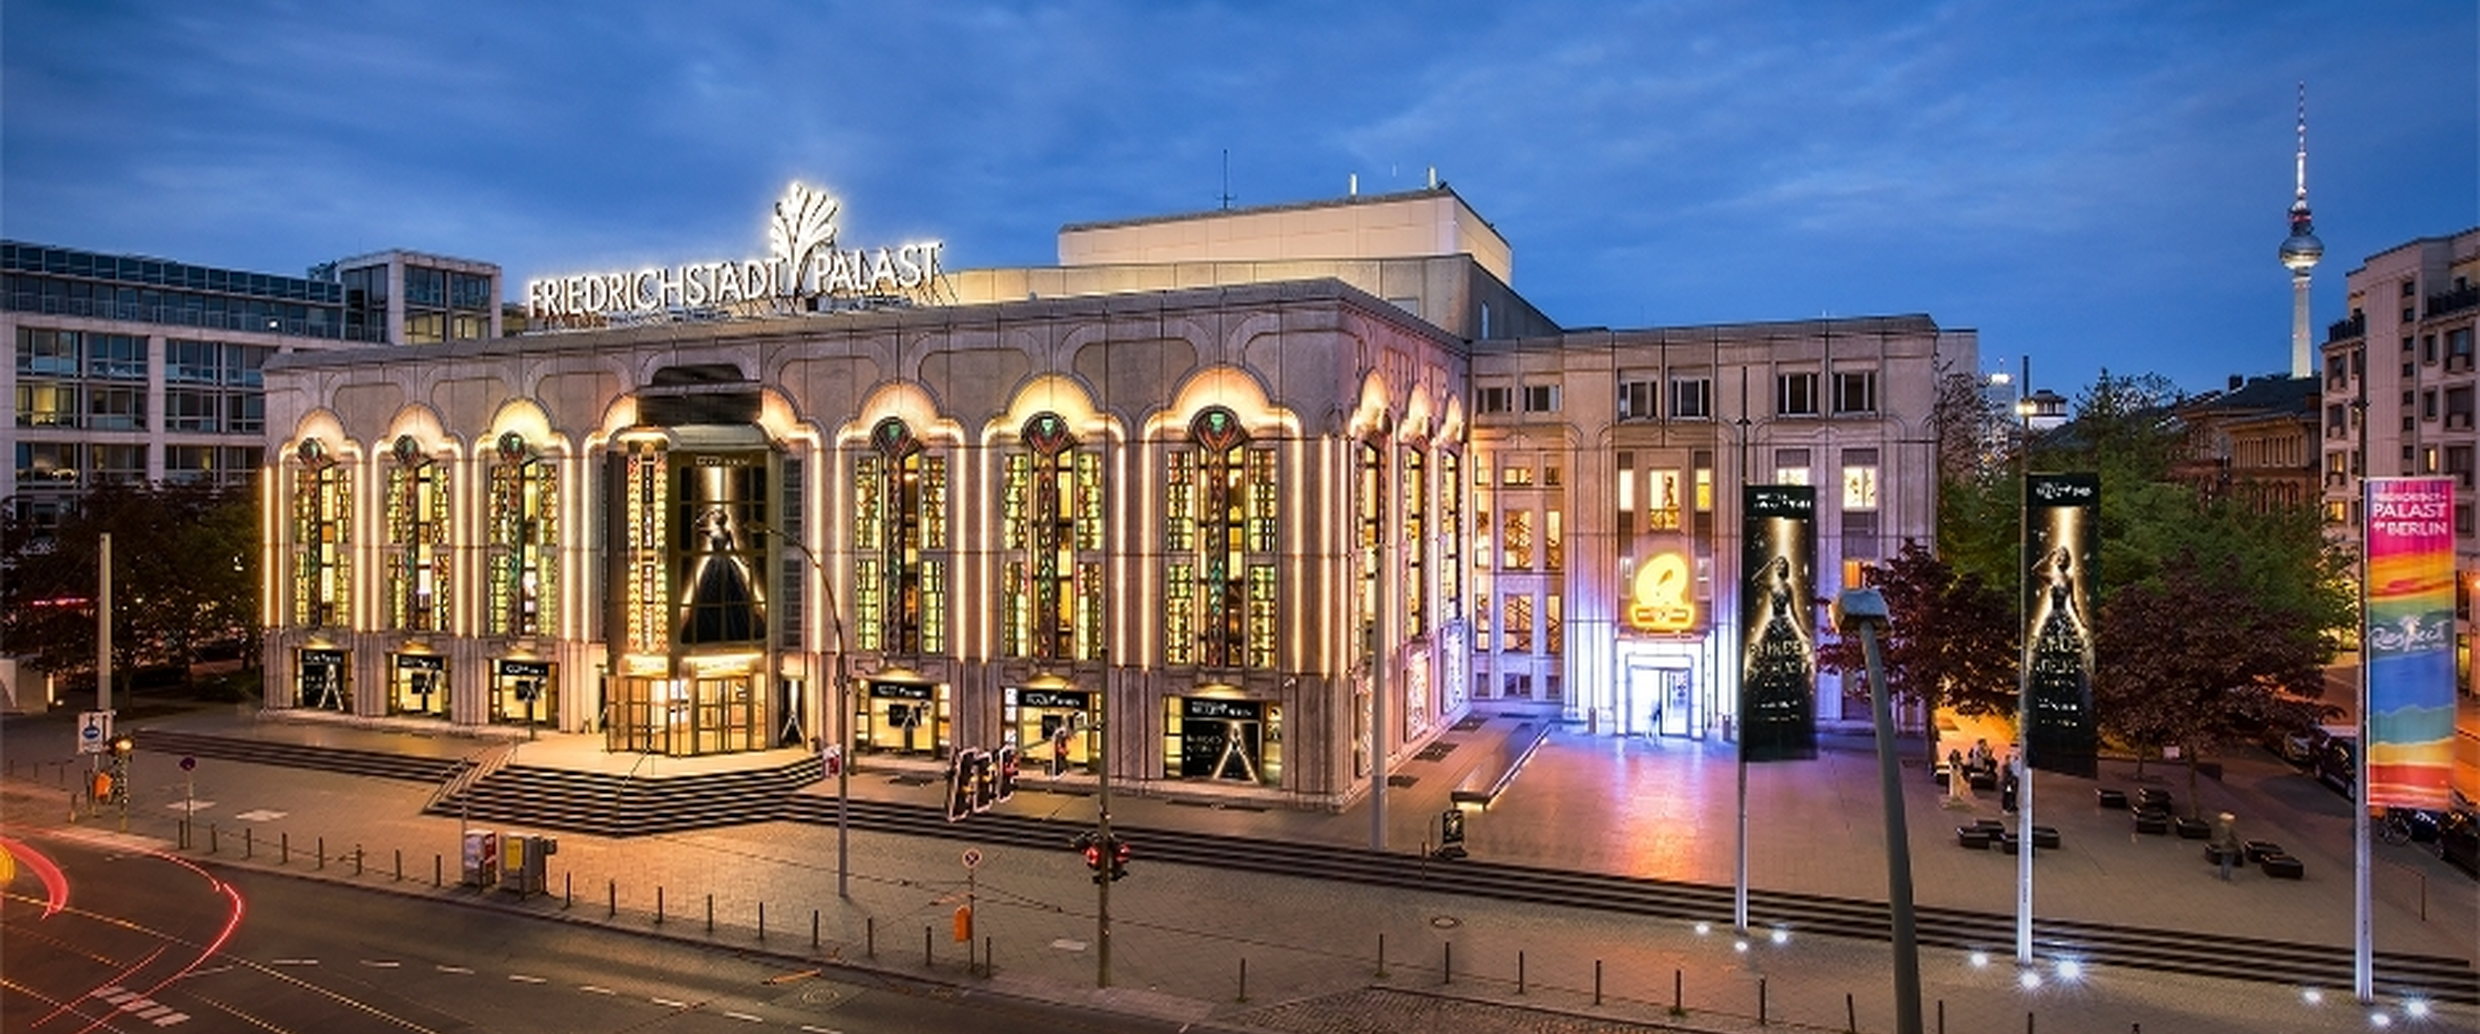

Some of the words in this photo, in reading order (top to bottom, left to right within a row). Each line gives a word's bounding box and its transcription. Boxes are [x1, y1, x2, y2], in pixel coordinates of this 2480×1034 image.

[527, 258, 779, 316] FRIEDRICHSTADT
[813, 241, 944, 294] PALAST
[2373, 503, 2447, 518] PALAST
[2387, 521, 2447, 536] BERLIN
